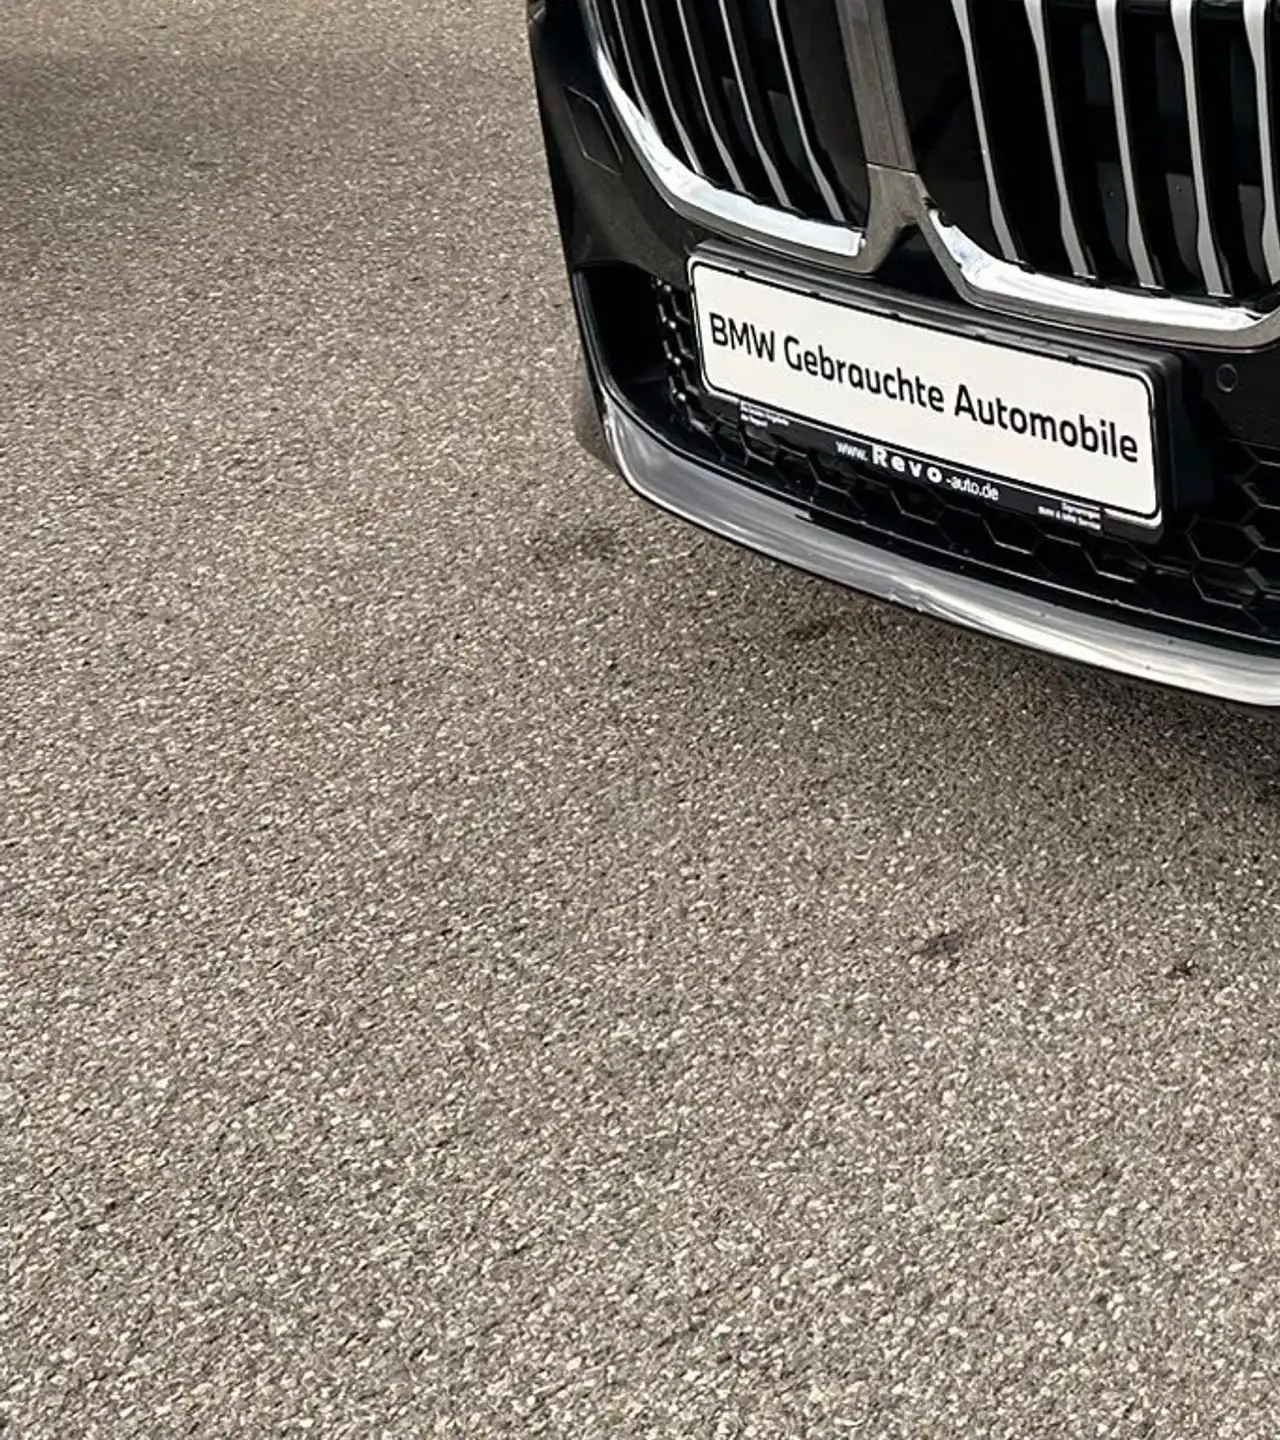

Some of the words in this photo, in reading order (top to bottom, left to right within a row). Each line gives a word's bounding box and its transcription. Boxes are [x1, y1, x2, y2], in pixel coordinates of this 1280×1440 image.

[709, 311, 776, 363] BMW
[783, 334, 945, 413] Gebrauchte
[954, 383, 1138, 463] Automobile
